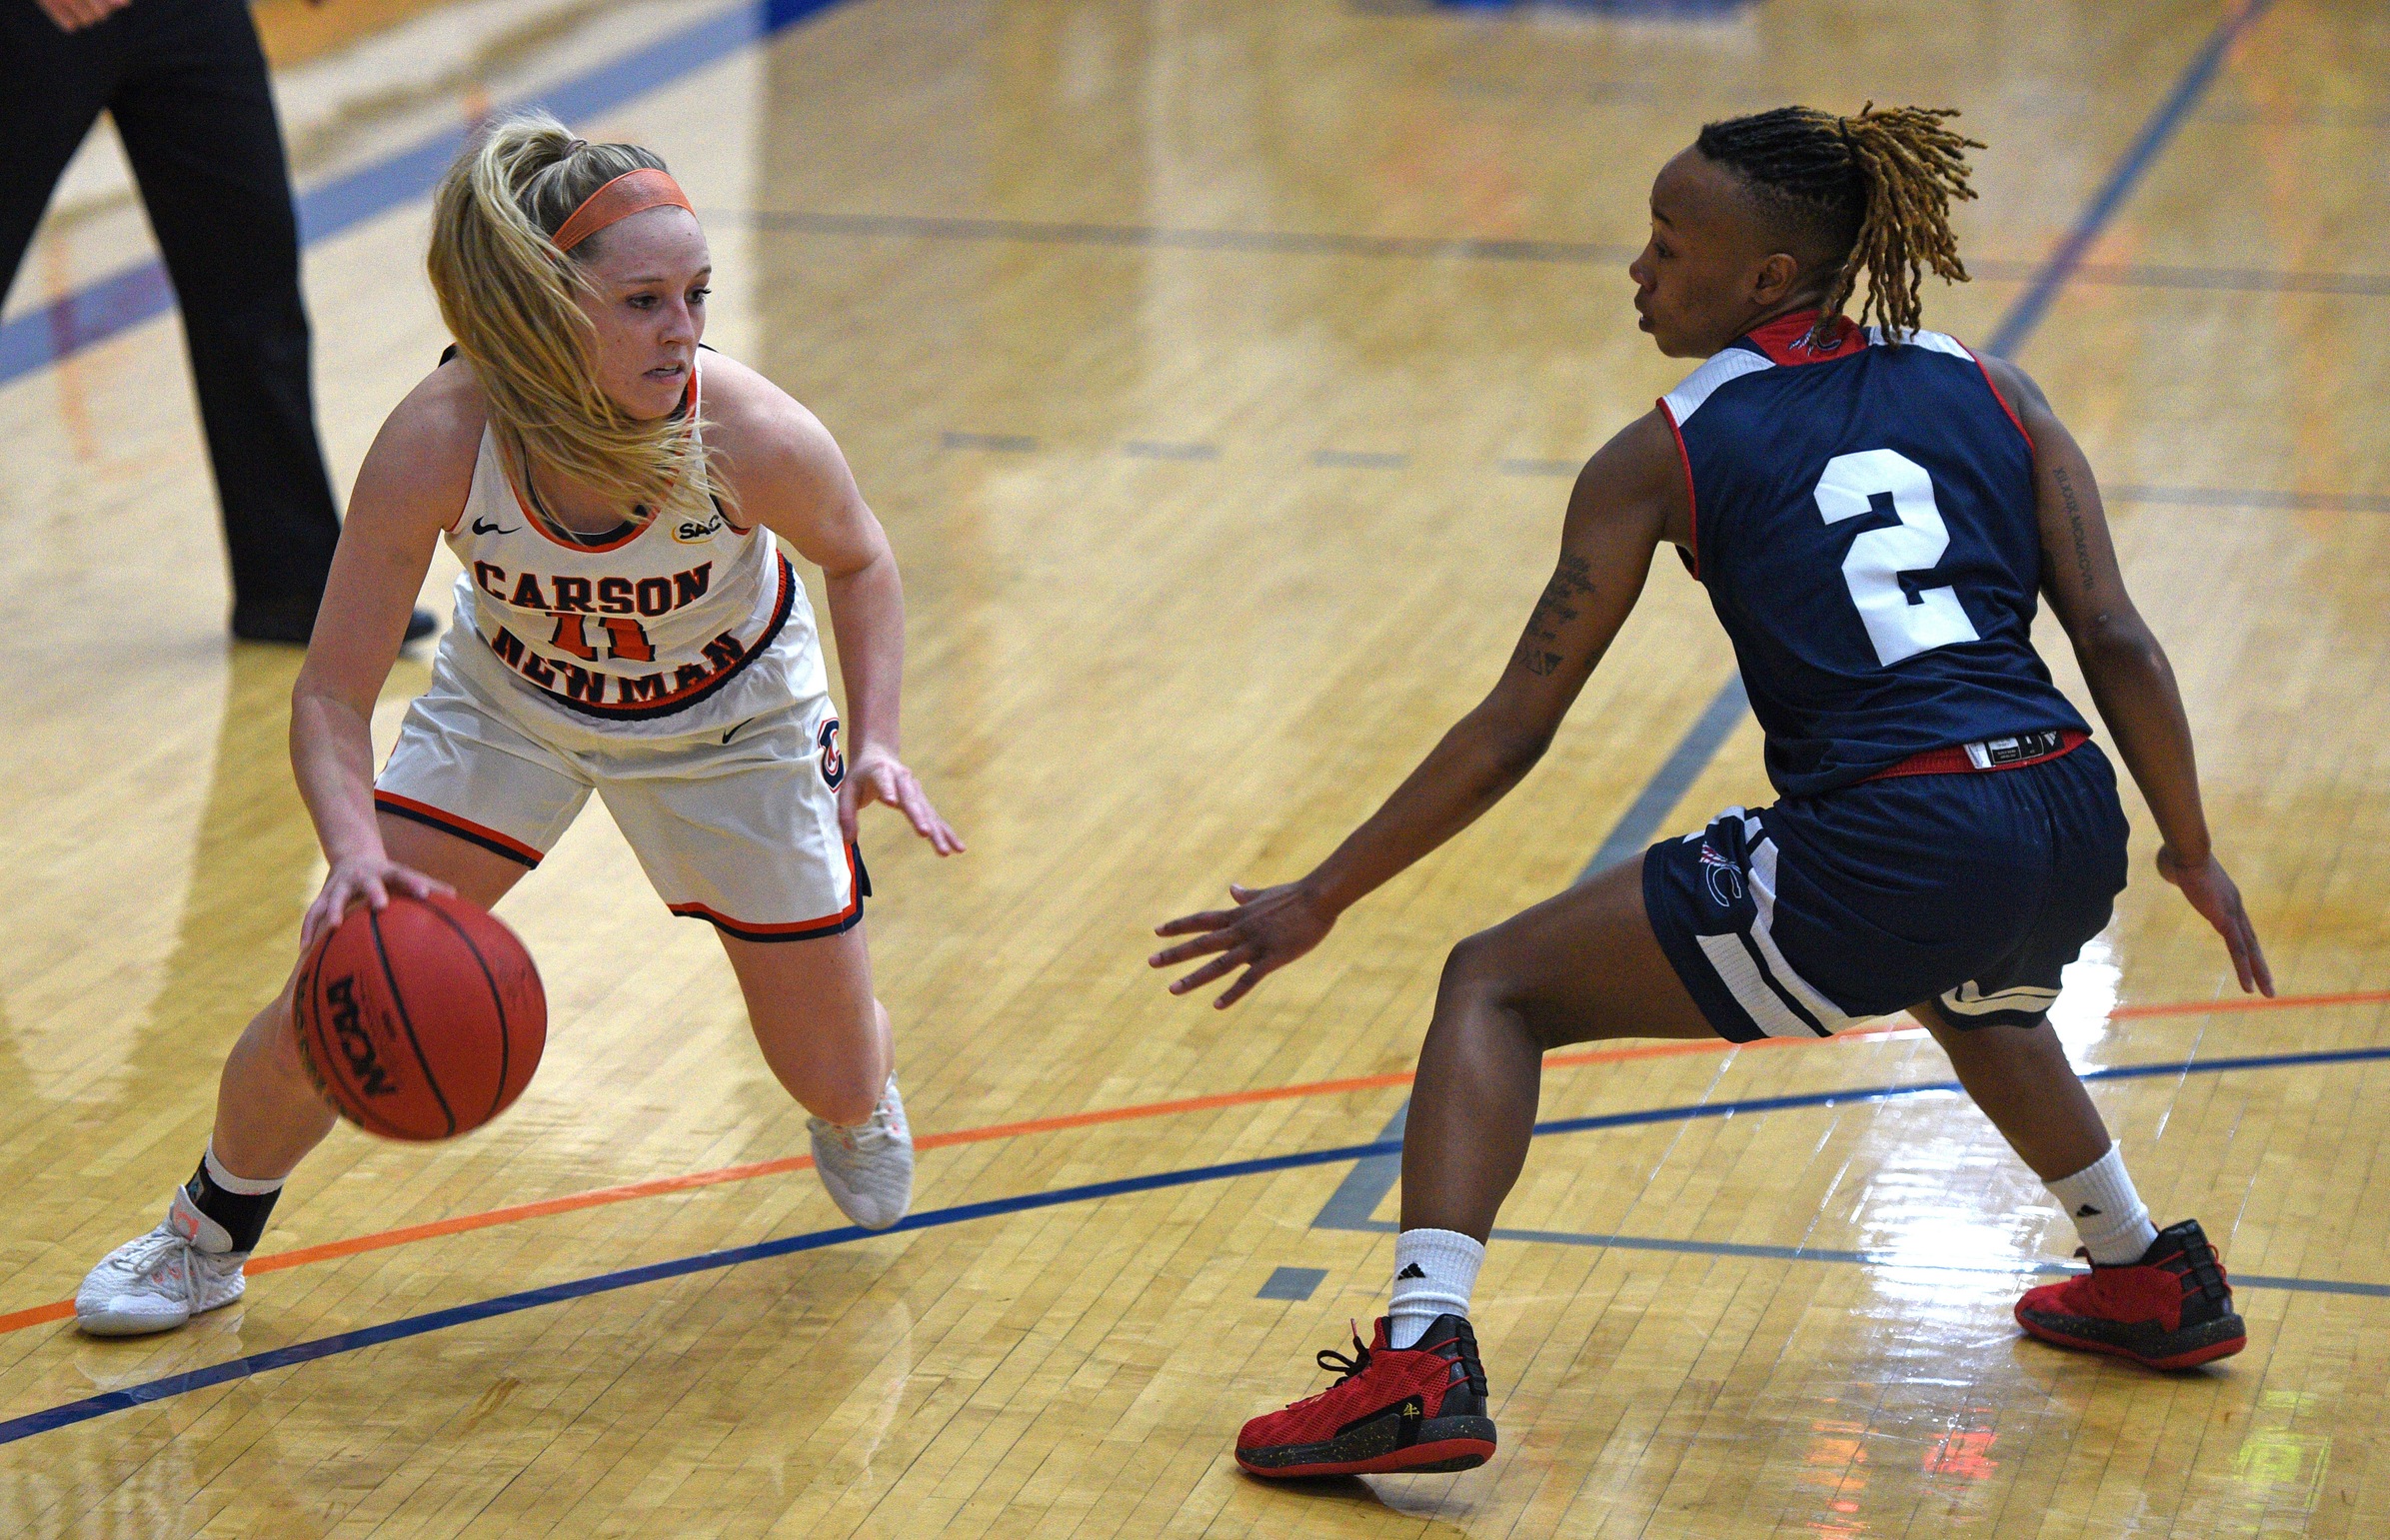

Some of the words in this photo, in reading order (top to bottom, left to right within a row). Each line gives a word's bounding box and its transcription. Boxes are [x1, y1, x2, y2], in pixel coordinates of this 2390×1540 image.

[679, 514, 722, 540] SAC
[1813, 448, 1981, 668] 2
[473, 560, 713, 618] CARSON
[545, 611, 656, 663] 11
[326, 974, 397, 1096] NCAA
